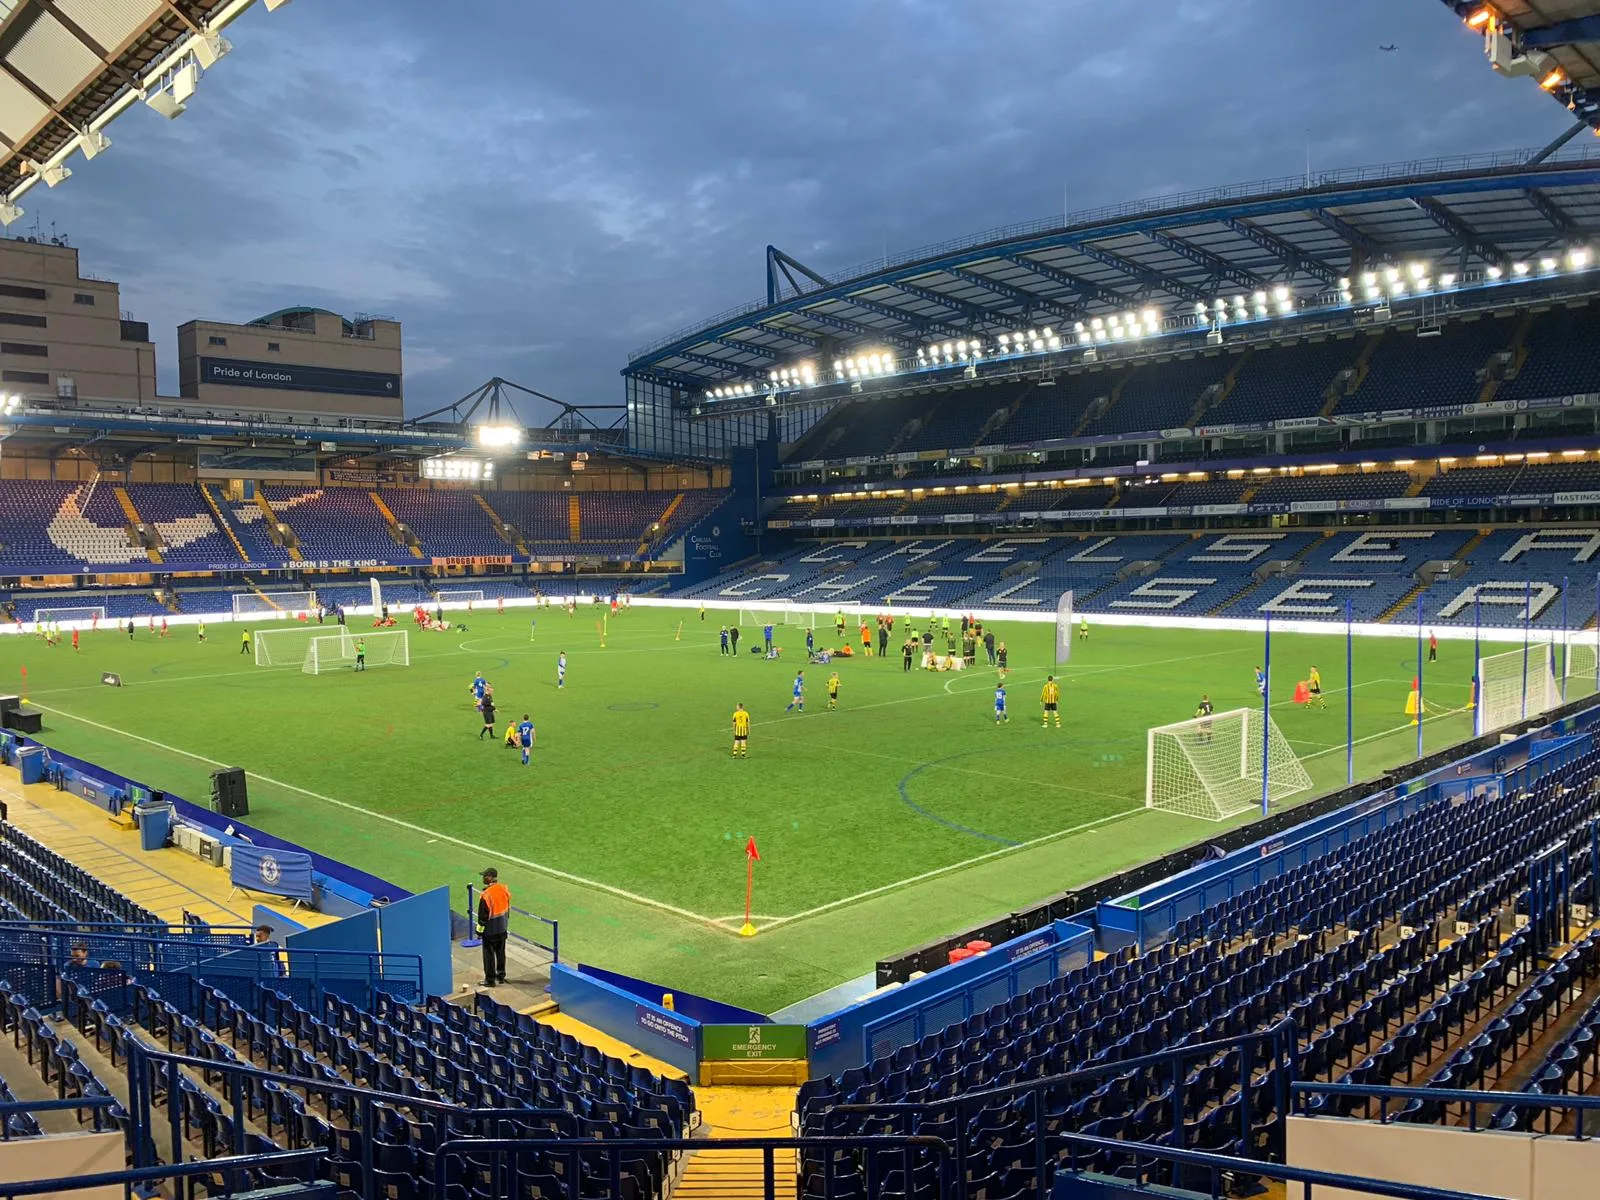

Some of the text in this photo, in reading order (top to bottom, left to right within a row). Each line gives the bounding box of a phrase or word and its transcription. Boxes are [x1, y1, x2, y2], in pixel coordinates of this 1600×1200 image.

[213, 366, 292, 381] Pride of London
[1424, 404, 1463, 412] MELBOURNE
[1467, 496, 1499, 505] LONDO
[1556, 492, 1600, 502] HASTINGS
[1349, 500, 1370, 508] CORK
[691, 535, 712, 543] CHELSEA
[289, 558, 377, 569] BORN IS THE KING
[445, 556, 506, 565] DROGBA LEGEND
[1205, 704, 1210, 712] 1
[640, 1016, 647, 1025] TO
[654, 1023, 667, 1033] ONTO
[666, 1028, 676, 1038] THE
[675, 1032, 689, 1043] PITCH
[662, 1020, 683, 1033] OFFENCE
[732, 1043, 777, 1051] EMERGENCY
[746, 1050, 763, 1058] EXIT
